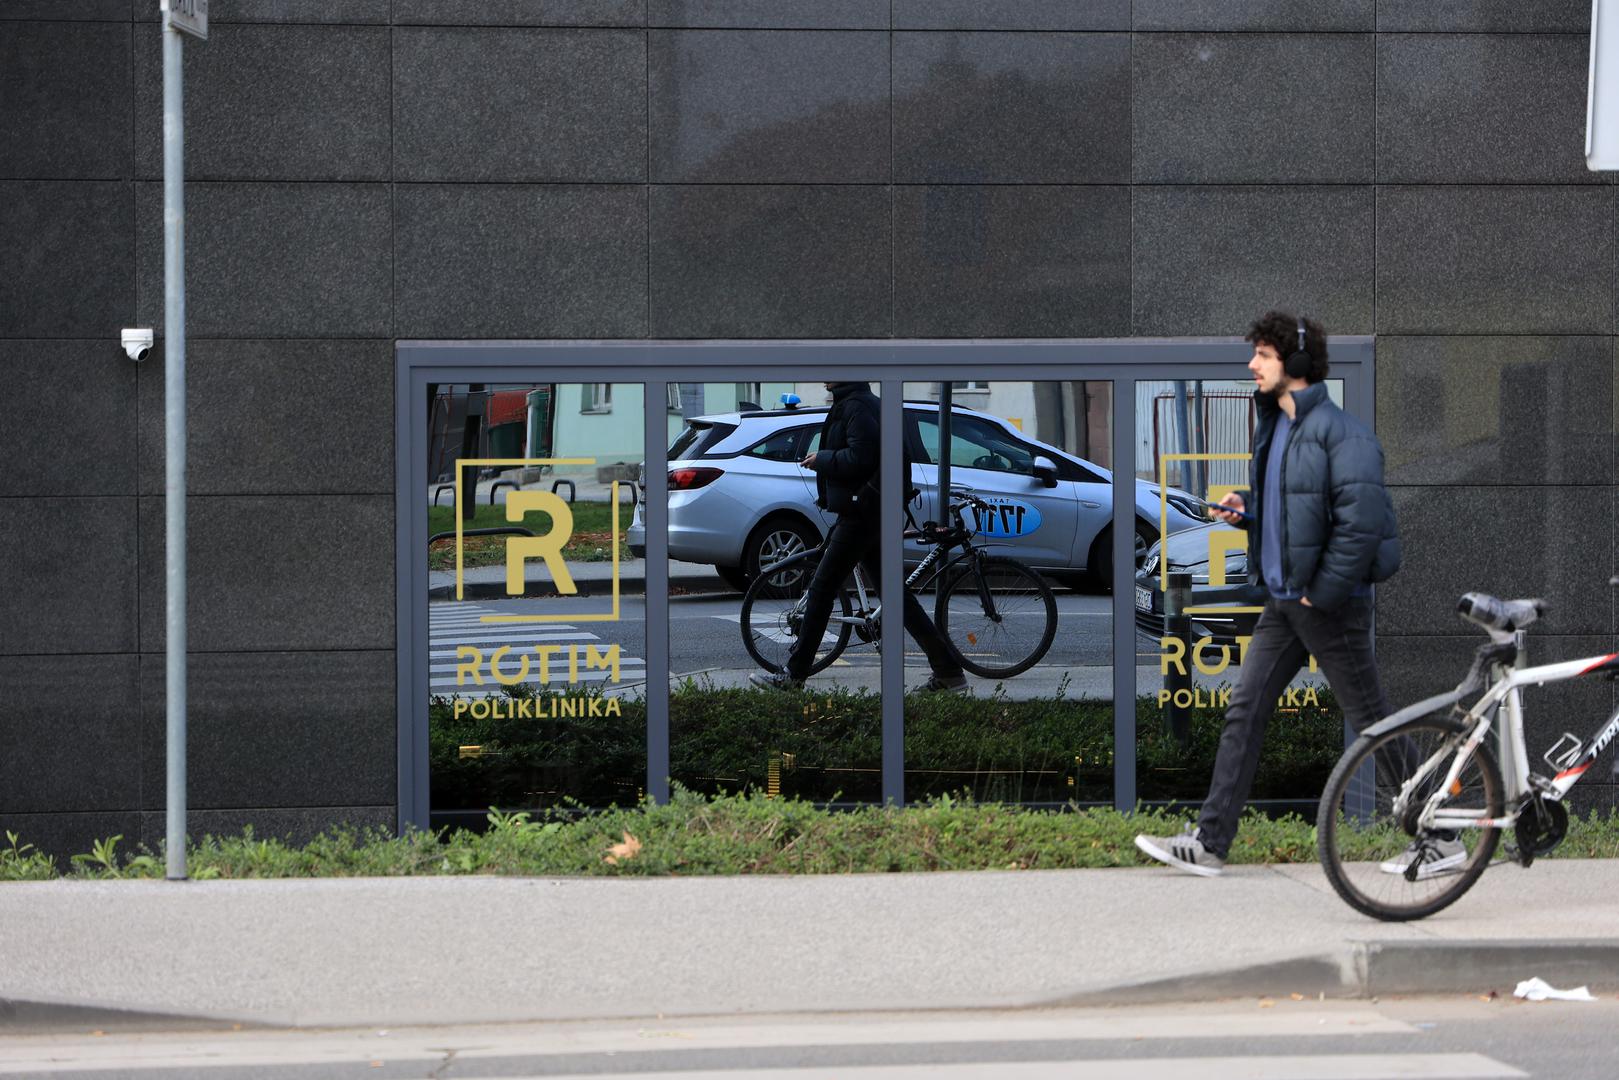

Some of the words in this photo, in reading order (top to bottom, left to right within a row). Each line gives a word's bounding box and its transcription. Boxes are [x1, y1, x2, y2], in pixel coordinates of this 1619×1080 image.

[506, 490, 578, 594] R
[457, 644, 620, 685] ROTIM
[454, 697, 622, 719] POLIKLINIKA
